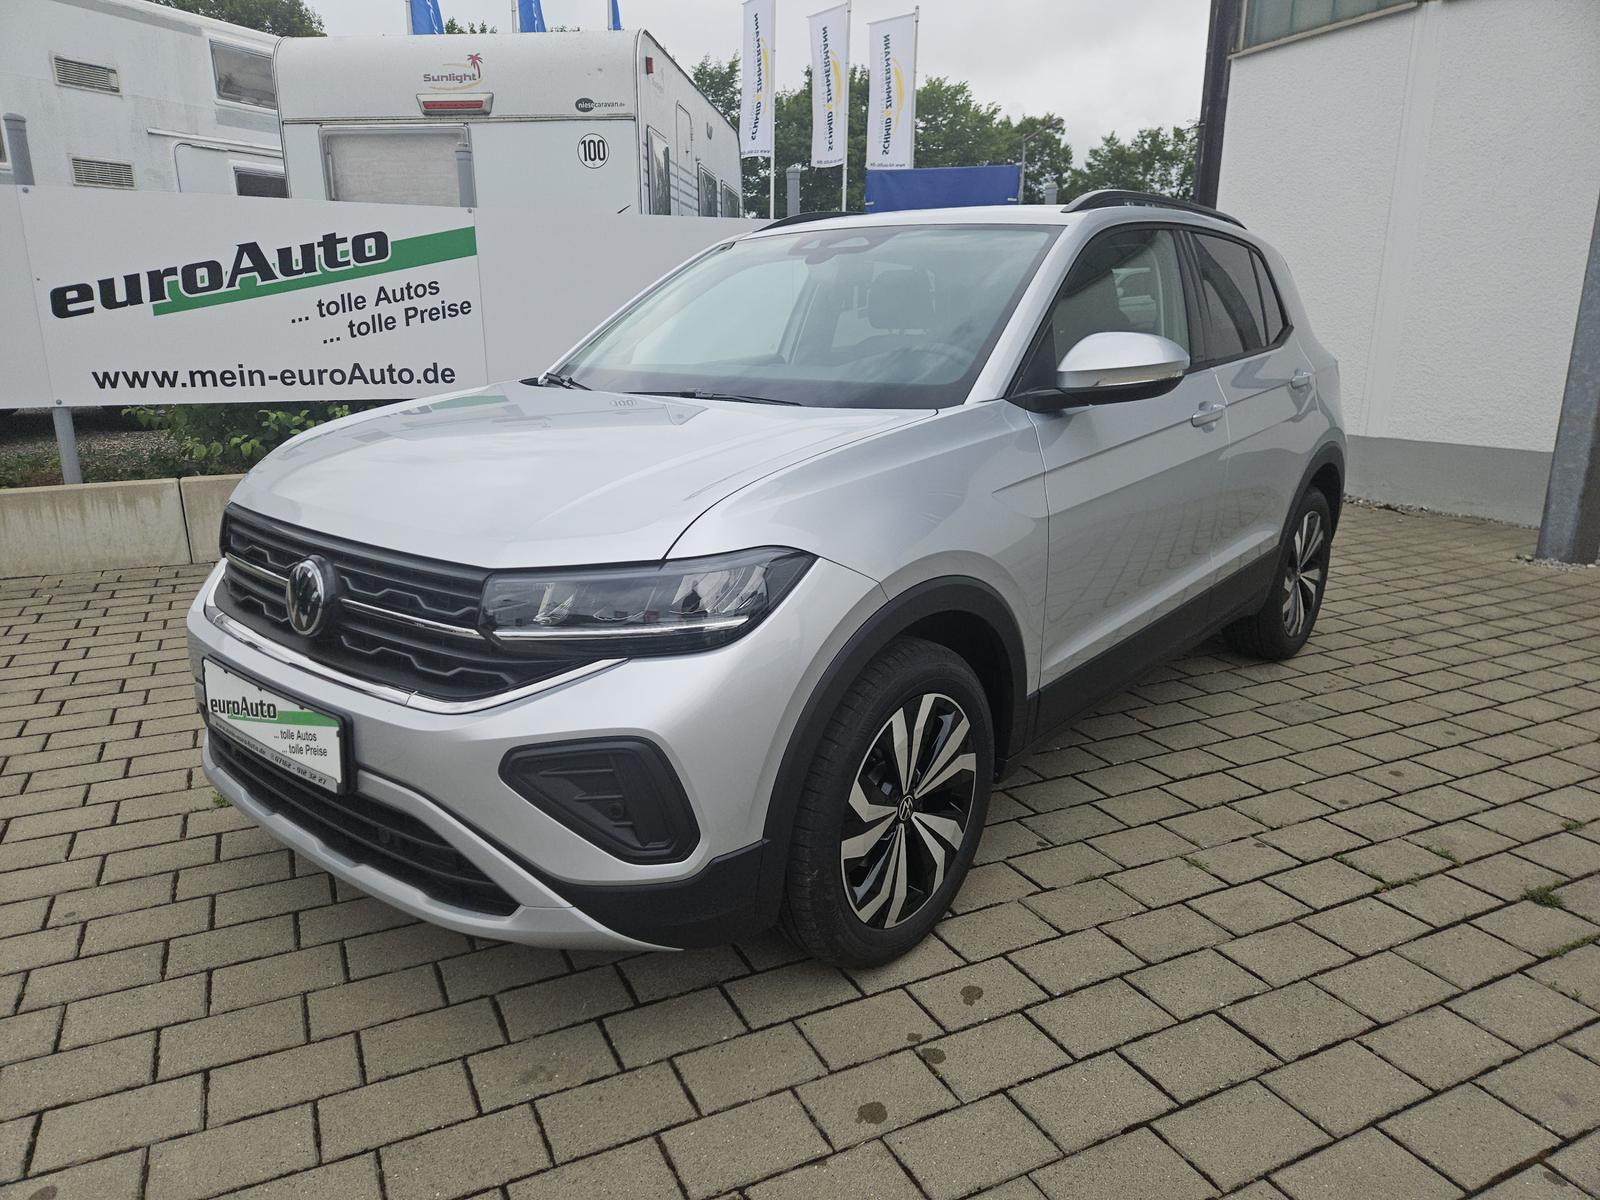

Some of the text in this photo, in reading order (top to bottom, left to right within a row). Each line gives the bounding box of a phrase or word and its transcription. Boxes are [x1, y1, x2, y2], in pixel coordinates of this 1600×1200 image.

[423, 73, 477, 83] Sunlight
[580, 139, 606, 161] 100
[50, 231, 389, 319] euroAuto
[316, 292, 367, 318] tolle
[374, 280, 440, 307] Autos
[348, 313, 397, 338] tolle
[404, 300, 472, 327] Preise
[91, 362, 456, 389] www.mein-euroAuto.de
[210, 696, 277, 719] euroAuto
[280, 728, 295, 740] tolle
[296, 730, 317, 742] Autos
[288, 744, 303, 755] tolle
[305, 744, 327, 757] Preise
